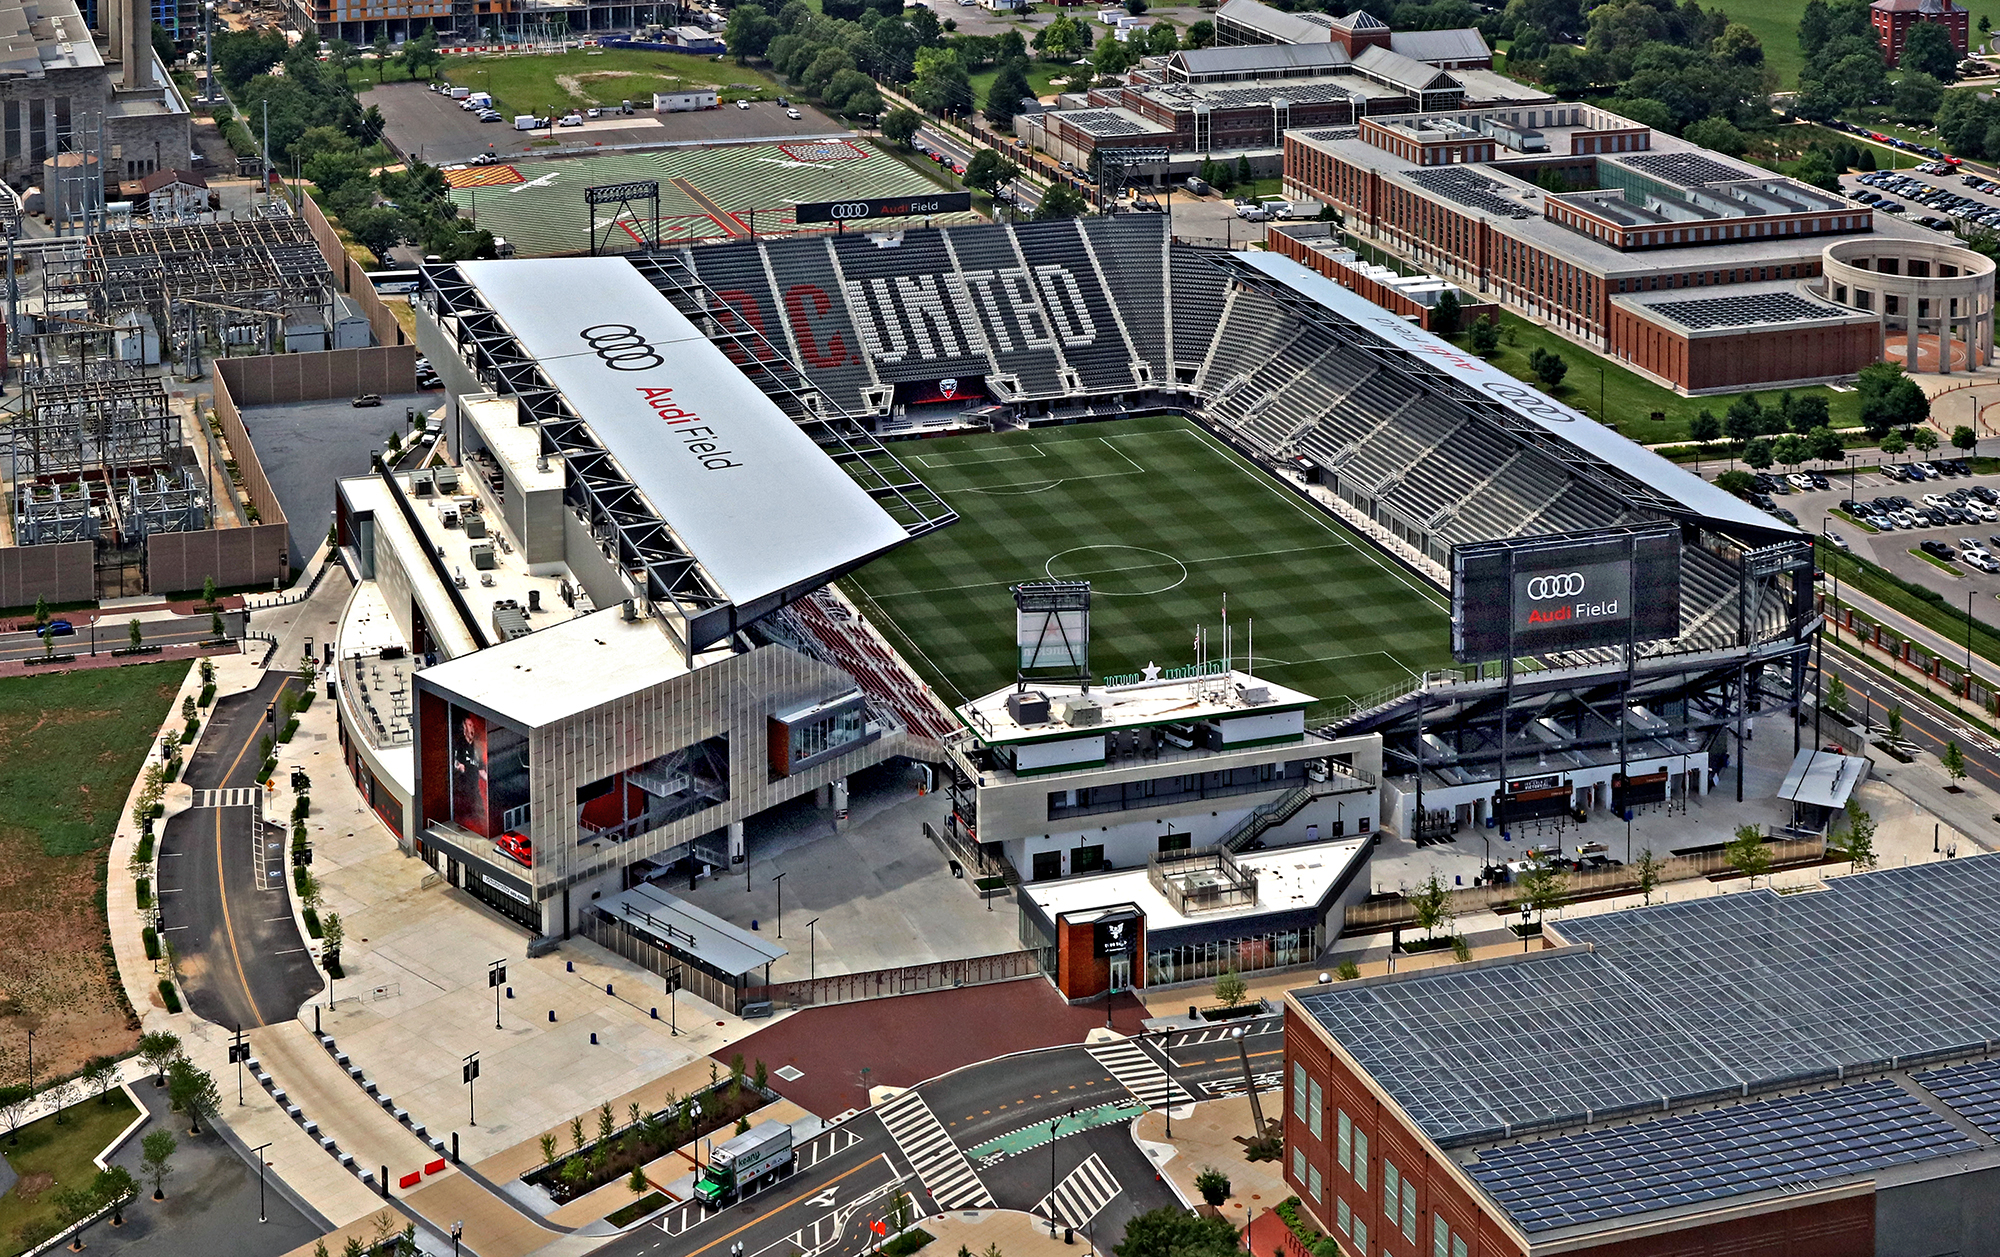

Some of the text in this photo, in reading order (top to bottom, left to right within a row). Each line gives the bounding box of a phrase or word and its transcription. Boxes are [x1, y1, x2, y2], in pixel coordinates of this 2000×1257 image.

[880, 201, 939, 214] Audi Field
[846, 264, 1097, 363] UNITED
[1367, 317, 1485, 373] Audi Field
[636, 387, 743, 470] Audi Field
[1528, 599, 1618, 624] Audi Field
[738, 1150, 761, 1167] keany
